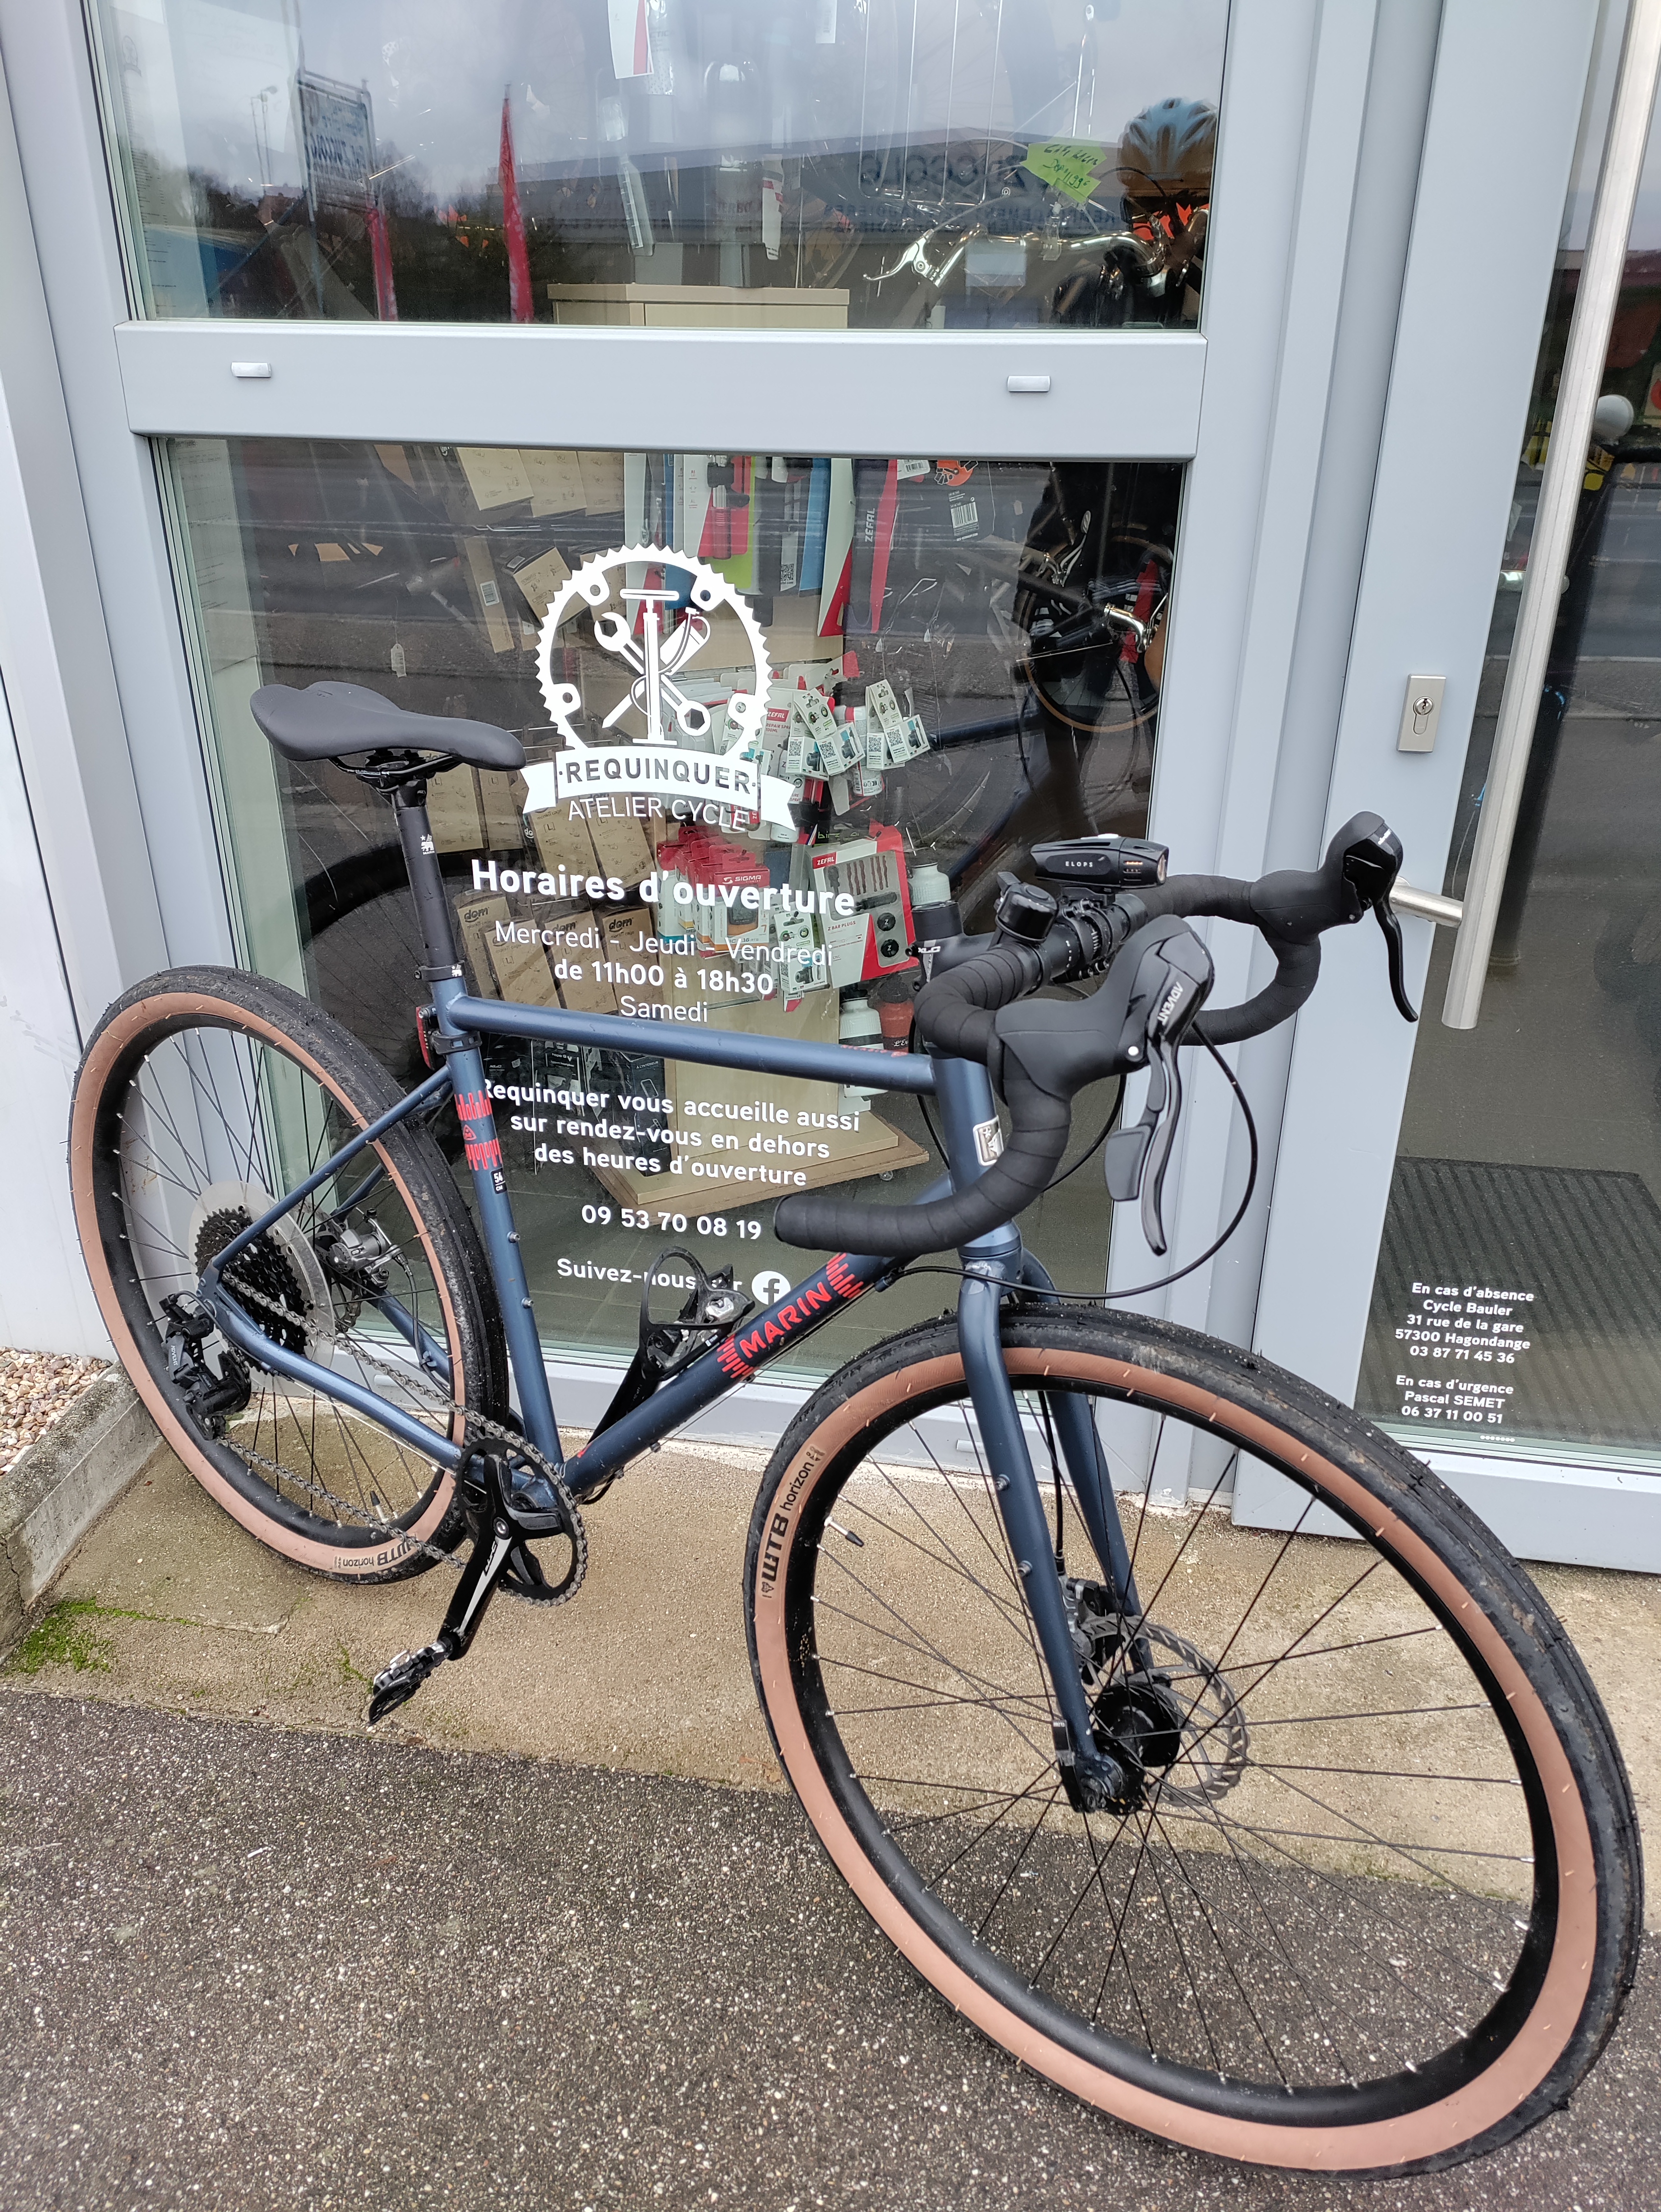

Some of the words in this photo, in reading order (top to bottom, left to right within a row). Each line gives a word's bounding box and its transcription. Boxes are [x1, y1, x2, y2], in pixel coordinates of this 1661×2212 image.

[865, 508, 875, 542] ZEFAL
[566, 758, 751, 795] REQUINQUER
[568, 796, 663, 821] ATELIER
[671, 798, 747, 832] CYCLE
[817, 856, 834, 865] ZEFAL
[471, 859, 625, 901] Horaires
[639, 870, 854, 916] d'ouverture
[609, 918, 633, 929] dom
[496, 920, 599, 949] Mercredi
[629, 930, 695, 956] Jeudi
[725, 937, 833, 965] Vendredi
[918, 945, 941, 953] XLC
[554, 958, 582, 981] de
[591, 961, 664, 986] 11h00
[674, 967, 687, 989] à
[696, 968, 774, 995] 18h30
[620, 995, 708, 1023] Samedi
[1157, 981, 1183, 1026] ADVENT
[484, 1078, 610, 1111] Requinquer
[617, 1093, 674, 1114] vous
[684, 1099, 790, 1125] accueille
[796, 1110, 860, 1132] aussi
[510, 1115, 547, 1133] sur
[556, 1118, 702, 1148] rendez-vous
[711, 1132, 739, 1149] en
[748, 1132, 830, 1158] dehors
[493, 1172, 503, 1183] 54
[535, 1143, 575, 1165] des
[583, 1150, 661, 1172] heures
[669, 1155, 807, 1187] d'ouverture
[581, 1205, 611, 1226] 09
[621, 1208, 650, 1229] 53
[659, 1211, 687, 1233] 70
[696, 1216, 727, 1237] 08
[737, 1219, 762, 1240] 19
[1412, 1282, 1430, 1294] En
[1435, 1286, 1459, 1296] cas
[1463, 1286, 1535, 1302] d'absence
[738, 1282, 834, 1359] MARIN
[1423, 1300, 1462, 1314] Cycle
[1466, 1303, 1513, 1316] Bauler
[1406, 1314, 1422, 1325] 31
[1427, 1318, 1450, 1327] rue
[1454, 1317, 1471, 1329] de
[1476, 1319, 1488, 1330] la
[1492, 1324, 1524, 1334] gare
[1395, 1329, 1440, 1342] 57300
[1445, 1332, 1531, 1351] Hagondange
[1410, 1345, 1428, 1357] 03
[1432, 1347, 1451, 1358] 87
[1455, 1349, 1469, 1360] 71
[1473, 1351, 1493, 1362] 45
[1496, 1353, 1515, 1363] 36
[1396, 1375, 1414, 1386] En
[1418, 1378, 1442, 1389] cas
[1446, 1379, 1514, 1394] d'urgence
[1405, 1391, 1449, 1405] Pascal
[1453, 1394, 1505, 1409] SEMET
[1401, 1405, 1420, 1416] 06
[1424, 1407, 1442, 1418] 37
[1445, 1409, 1458, 1420] 11
[1463, 1410, 1483, 1422] 00
[1487, 1412, 1503, 1424] 51
[761, 1512, 789, 1582] WTB
[779, 1461, 815, 1512] horizon
[343, 1556, 375, 1569] horizon
